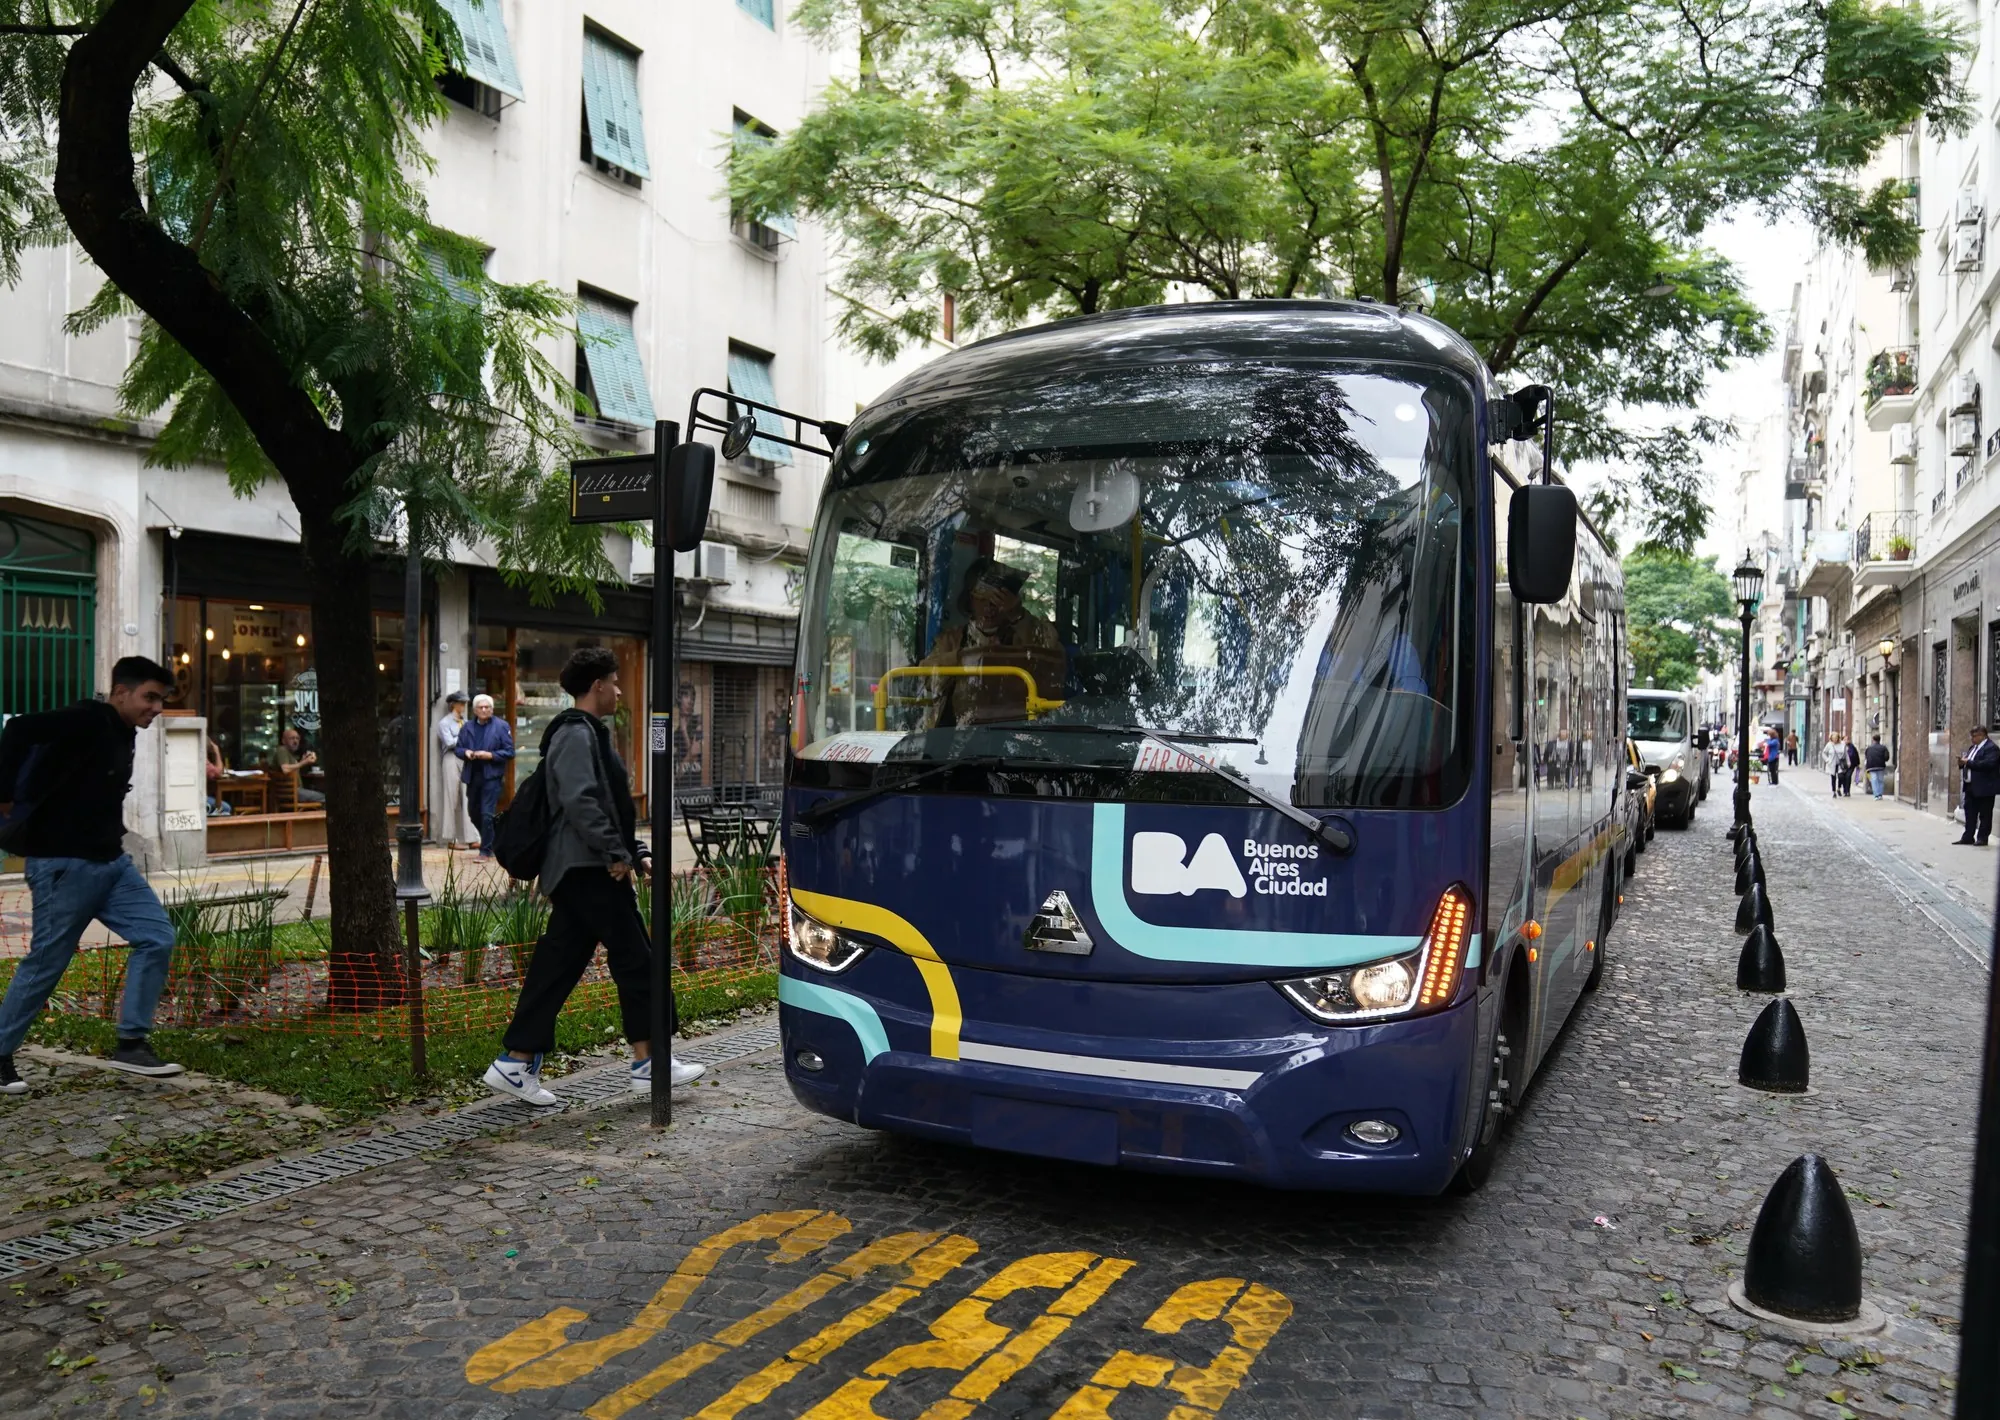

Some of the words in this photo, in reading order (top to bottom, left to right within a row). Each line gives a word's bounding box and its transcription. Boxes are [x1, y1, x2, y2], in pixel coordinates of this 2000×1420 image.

[1243, 839, 1319, 859] Buenos
[1131, 831, 1248, 899] BA
[1248, 858, 1300, 877] Aires
[1254, 876, 1328, 897] Ciudad
